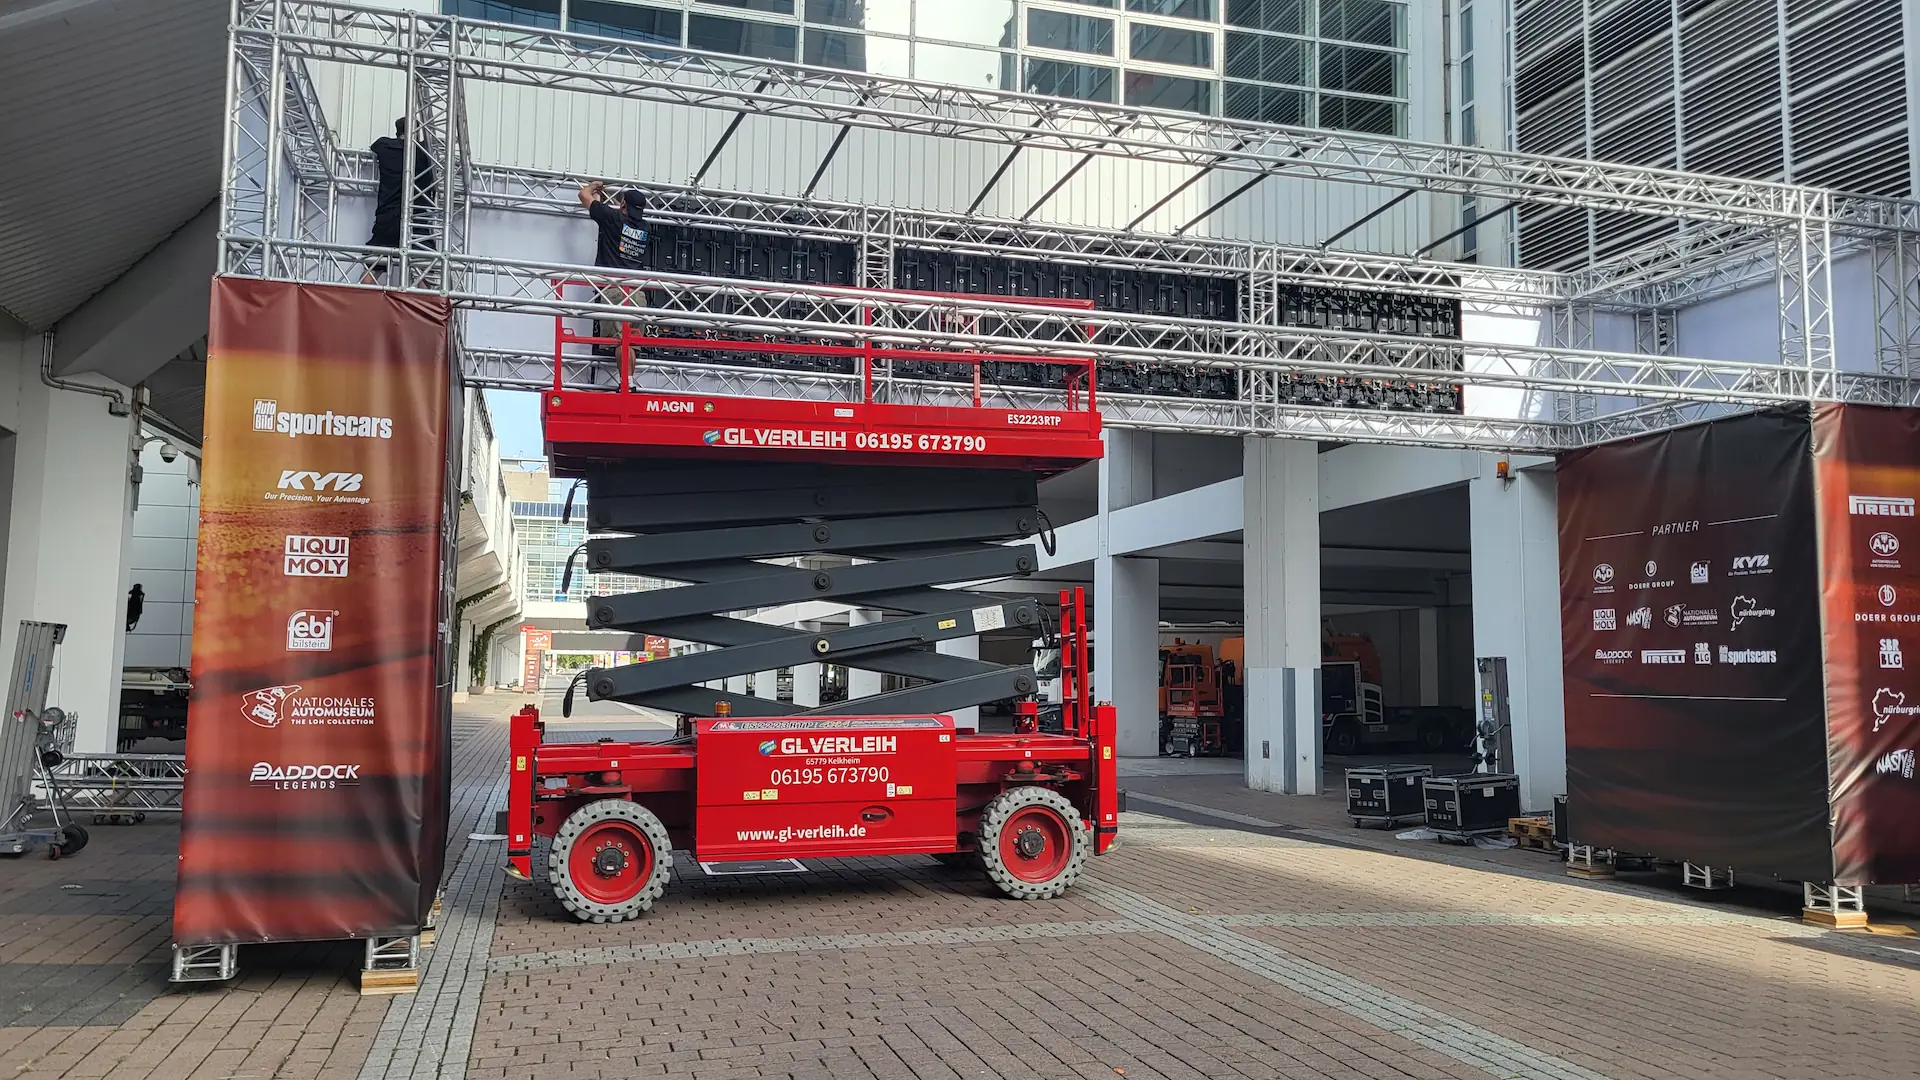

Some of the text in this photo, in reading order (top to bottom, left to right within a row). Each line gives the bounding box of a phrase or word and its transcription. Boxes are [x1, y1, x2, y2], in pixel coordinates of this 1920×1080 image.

[255, 400, 276, 415] Auto
[646, 400, 694, 413] MAGNI
[255, 414, 274, 430] Bild
[277, 410, 392, 439] sportscars
[1007, 414, 1062, 426] ES2223RTP
[724, 428, 752, 445] GL
[754, 429, 846, 447] VERLEIH
[855, 432, 913, 450] 06195
[918, 434, 986, 452] 673790
[277, 470, 364, 492] KYB
[264, 492, 370, 504] Our Precision, Your Advantage
[1849, 496, 1915, 516] PIRELLI
[1652, 520, 1700, 536] PARTNER
[289, 538, 346, 555] LIQUI
[288, 557, 346, 575] MOLY
[1732, 554, 1769, 569] KYB
[1652, 580, 1674, 588] GROUP
[1594, 610, 1614, 618] LIQUI
[1626, 607, 1646, 626] NASTY
[1739, 608, 1775, 617] nürburgring
[288, 612, 332, 638] febi
[1594, 621, 1614, 629] MOLY
[292, 639, 326, 648] bilstein
[1880, 639, 1899, 651] SBR
[1595, 649, 1633, 659] PADDOCK
[1641, 650, 1686, 663] PIRELLI
[1696, 653, 1709, 662] BLG
[1728, 649, 1776, 665] sportscars
[1881, 654, 1900, 665] BLG
[292, 697, 375, 707] NATIONALES
[291, 707, 375, 717] AUTOMUSEUM
[1883, 705, 1920, 715] nürburgri
[781, 738, 808, 754] GL
[809, 736, 896, 753] VERLEIH
[828, 757, 860, 765] Kelkheim
[1876, 748, 1908, 776] NASTY
[250, 762, 360, 782] PADDOCK
[771, 766, 889, 785] 06195 673790
[274, 781, 336, 790] LEGENDS
[737, 824, 866, 842] www.gl-verleih.de
